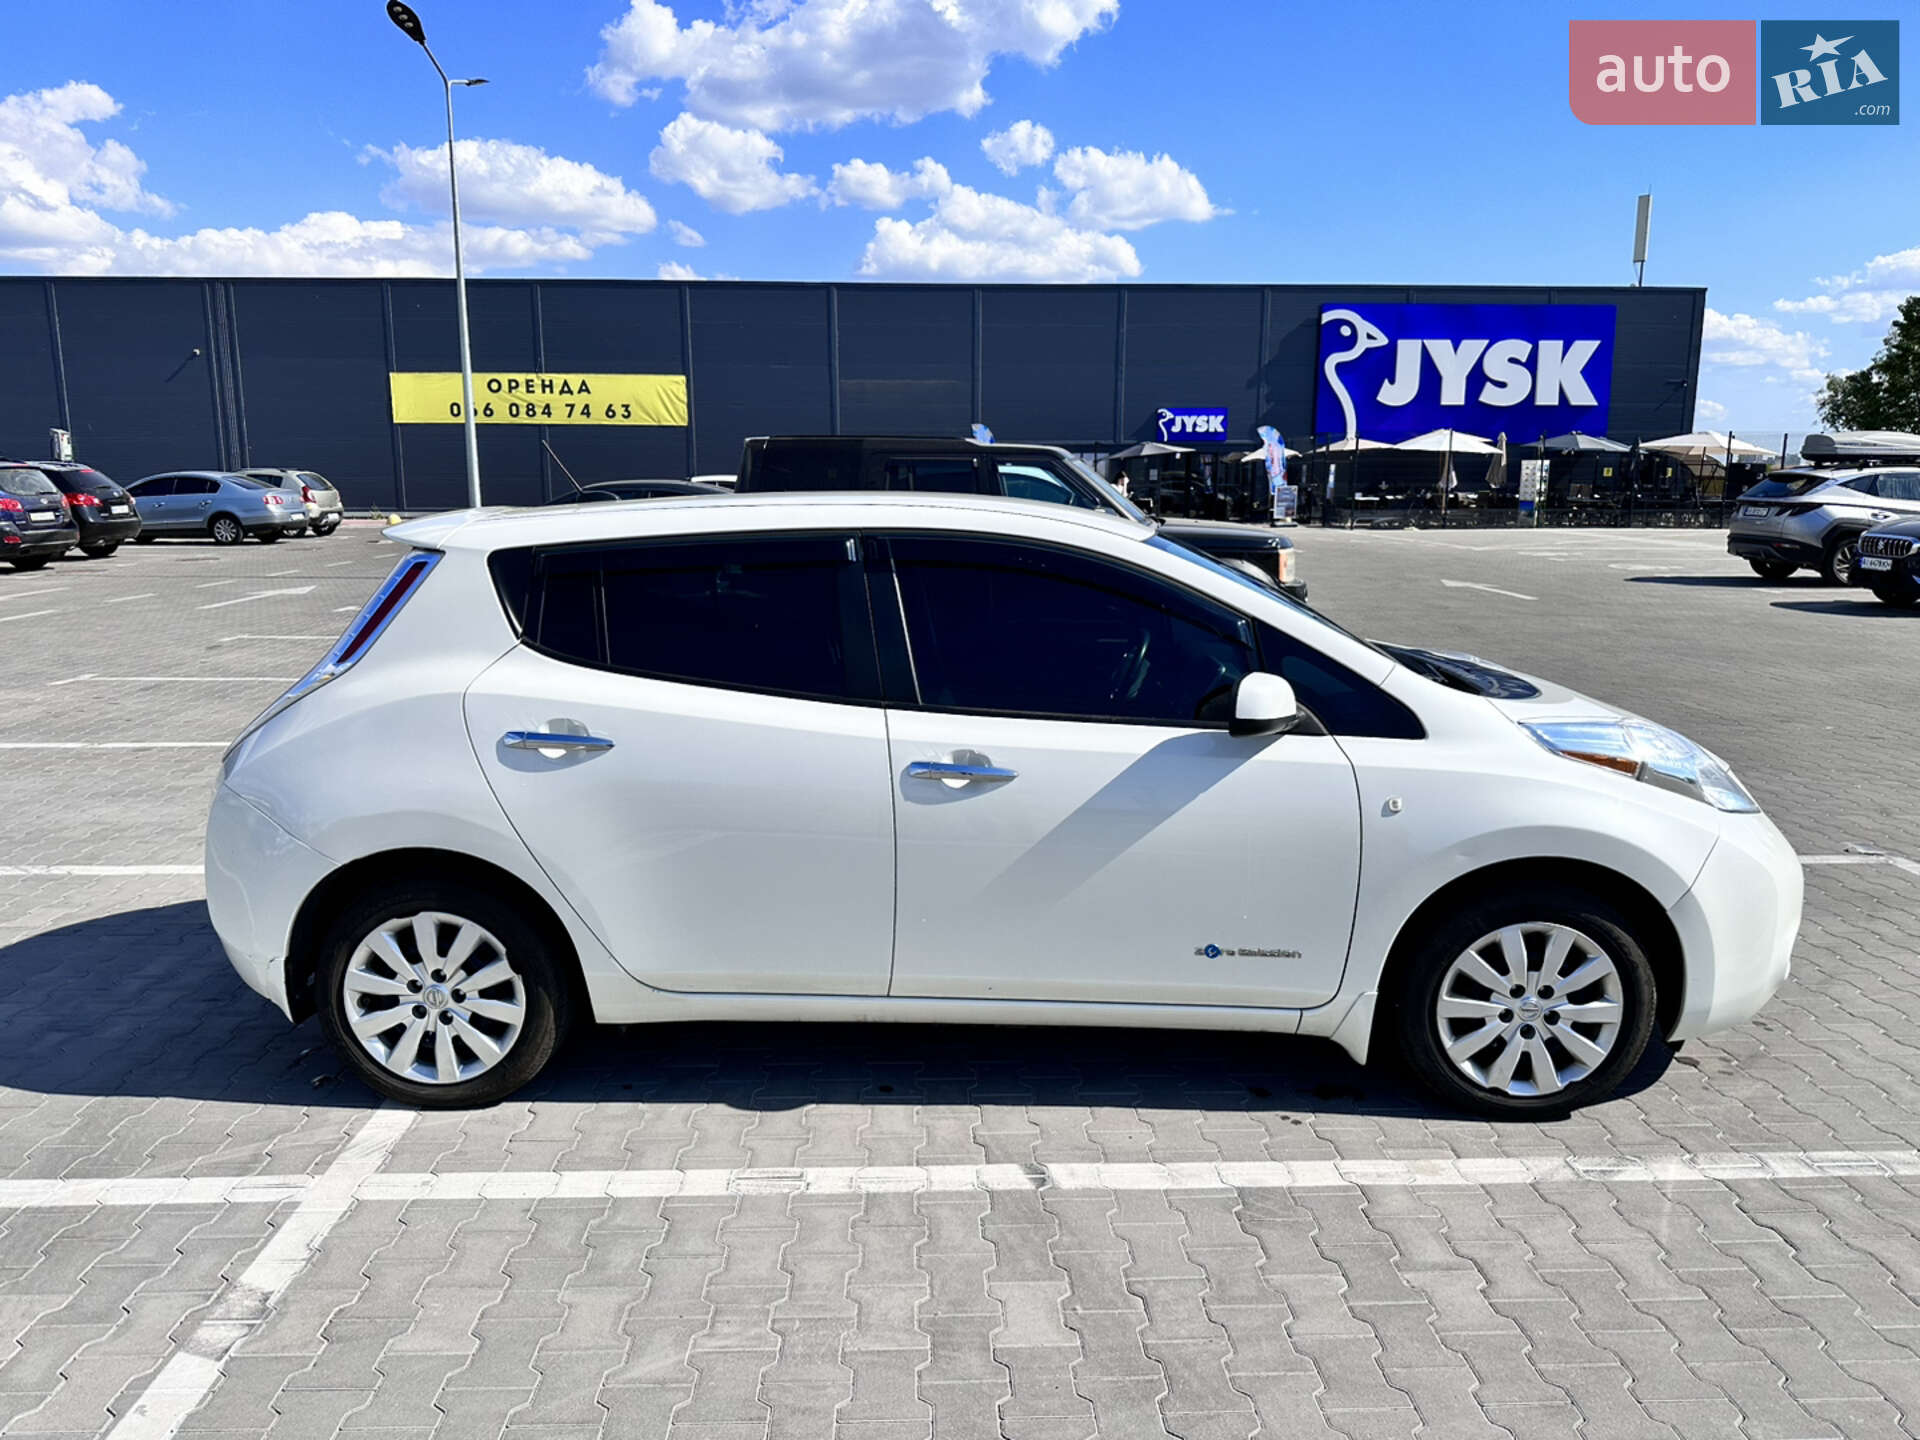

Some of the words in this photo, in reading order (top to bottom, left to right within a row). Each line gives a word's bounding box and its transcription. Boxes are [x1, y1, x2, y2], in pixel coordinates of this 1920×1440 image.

[1376, 338, 1602, 407] JYSK
[486, 378, 592, 396] ОРЕНДА
[449, 402, 494, 418] 06
[508, 402, 553, 419] 084
[564, 403, 592, 419] 74
[604, 403, 633, 420] 63
[1171, 415, 1225, 433] JYSK
